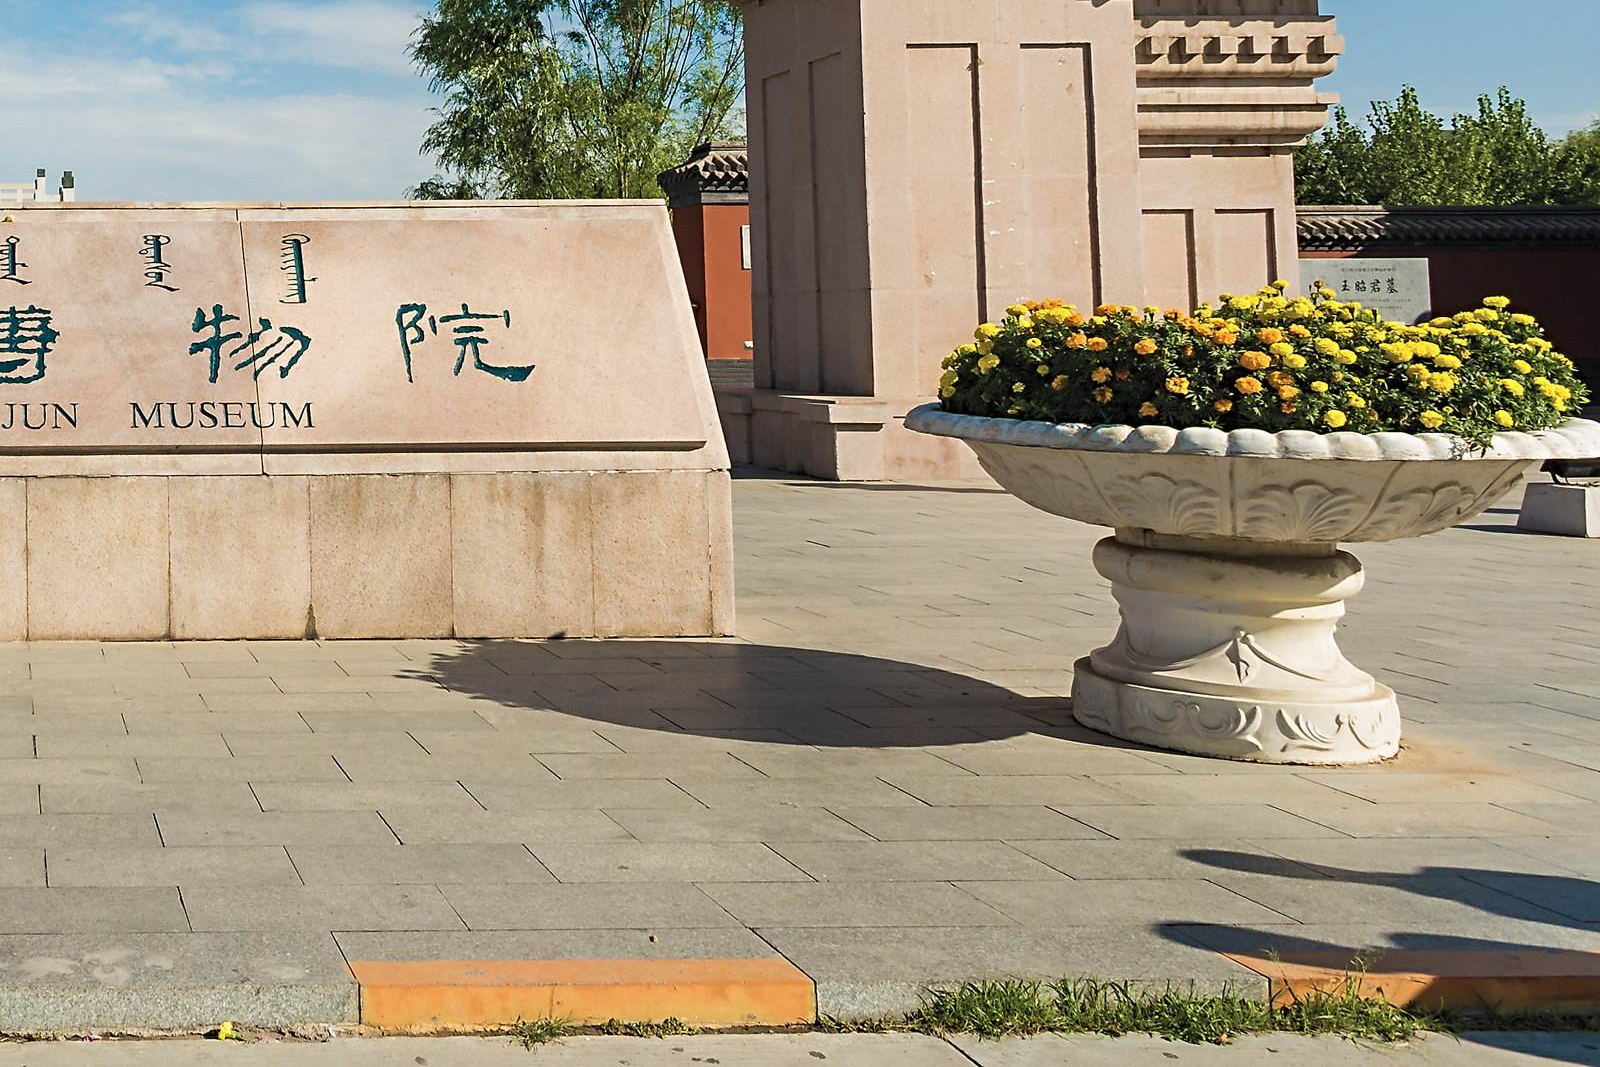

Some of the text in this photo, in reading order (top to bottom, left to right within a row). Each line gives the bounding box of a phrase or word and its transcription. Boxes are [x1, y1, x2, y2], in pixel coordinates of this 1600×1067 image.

[1341, 277, 1399, 294] 王昭君墓
[1, 402, 79, 430] JUN
[129, 401, 316, 429] MUSEUM
